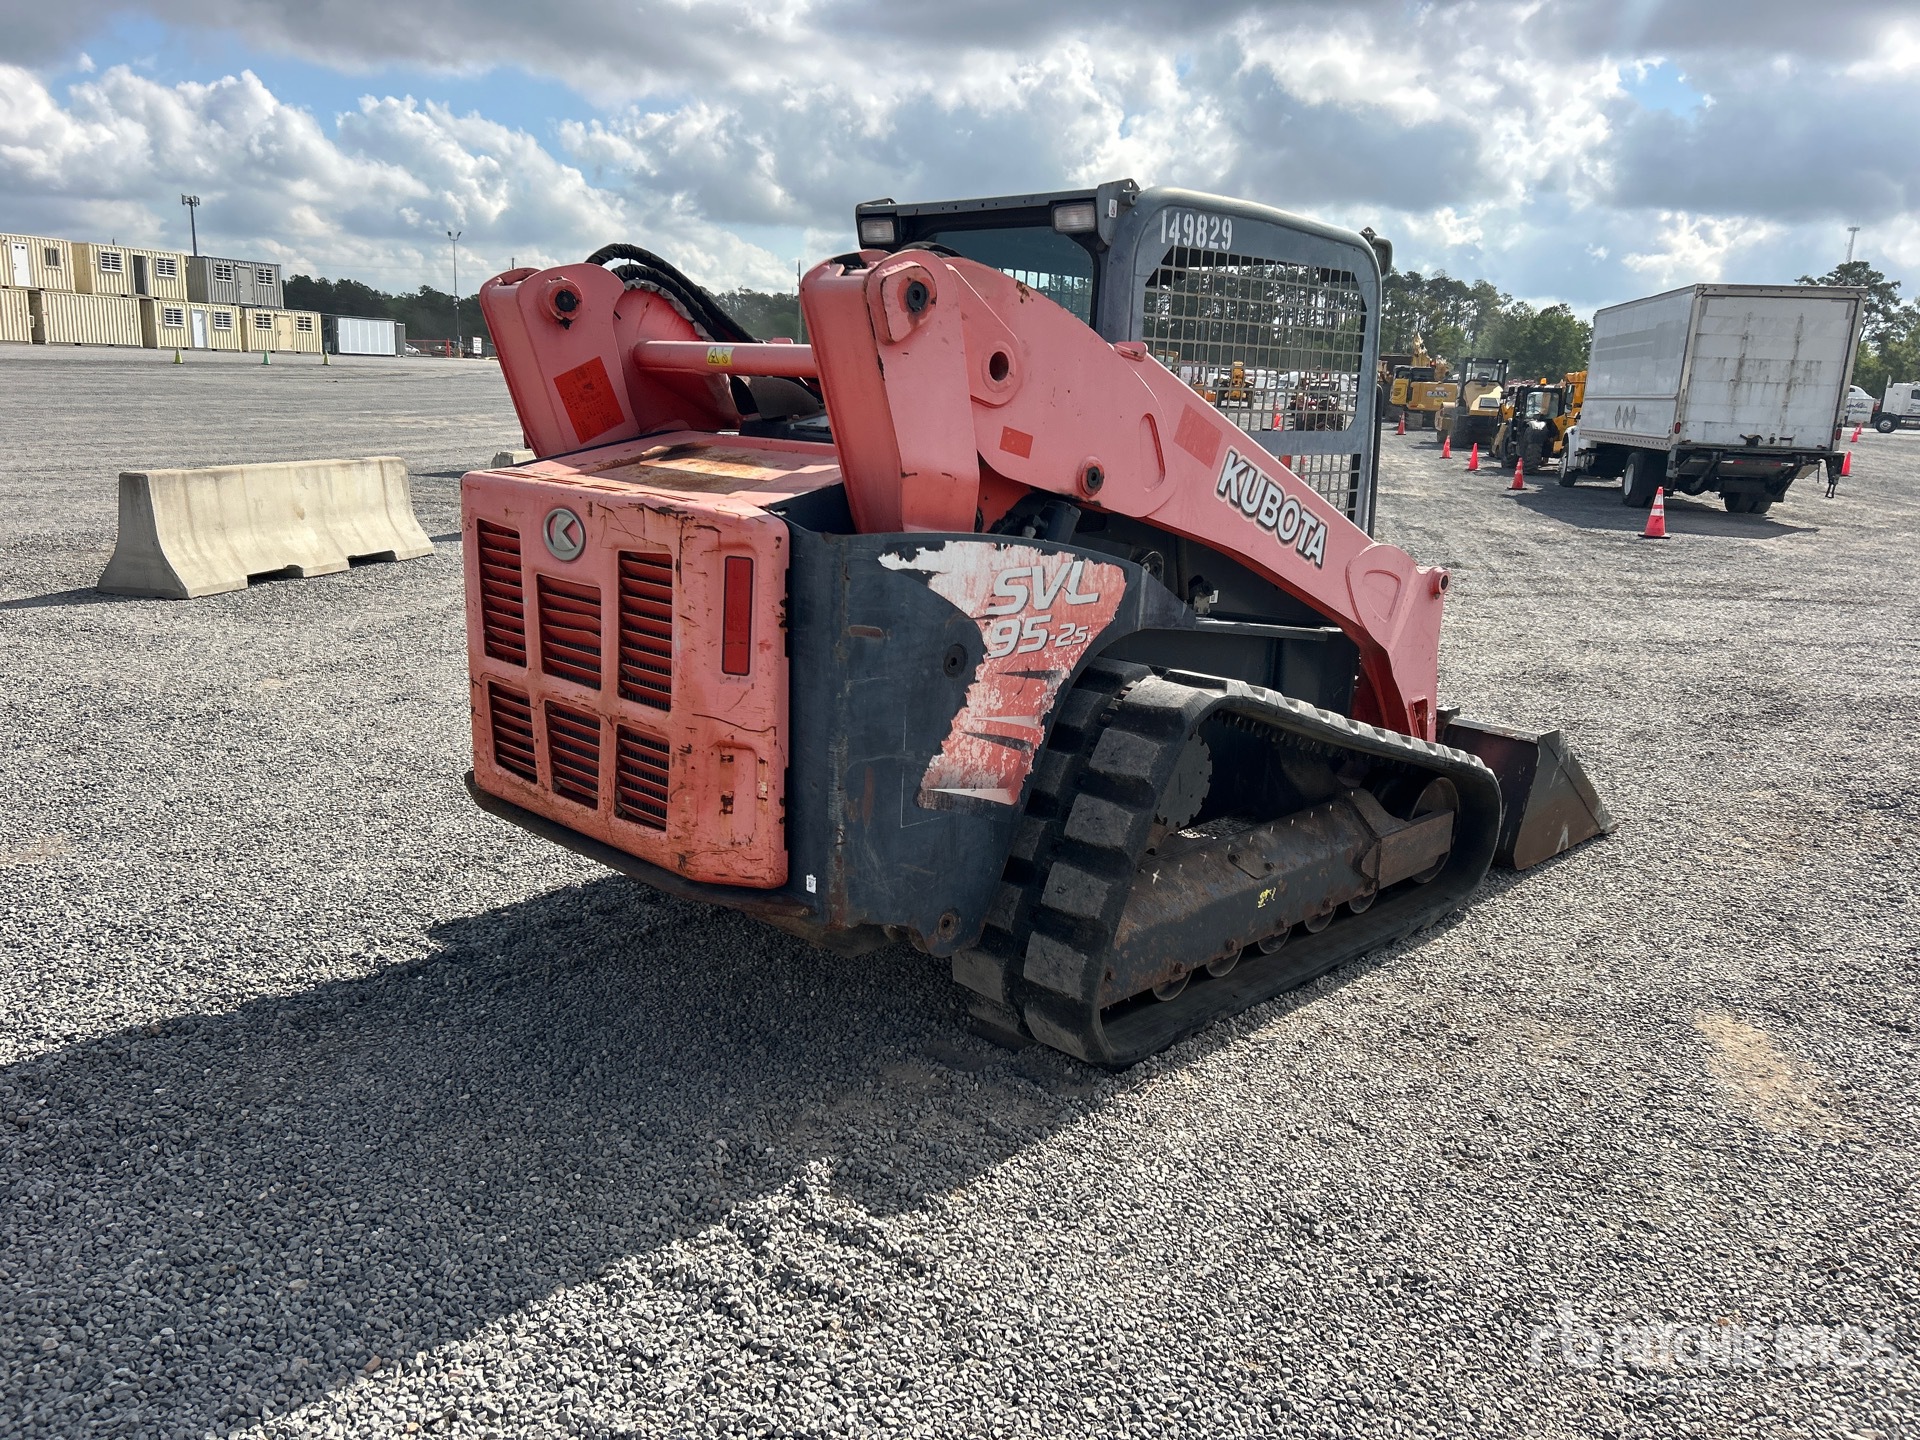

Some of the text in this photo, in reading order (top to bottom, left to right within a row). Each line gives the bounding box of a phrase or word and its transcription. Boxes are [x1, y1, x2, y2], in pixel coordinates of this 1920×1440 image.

[1160, 209, 1233, 251] 149829
[1216, 449, 1328, 569] KUBOTA
[985, 560, 1100, 616] SVL
